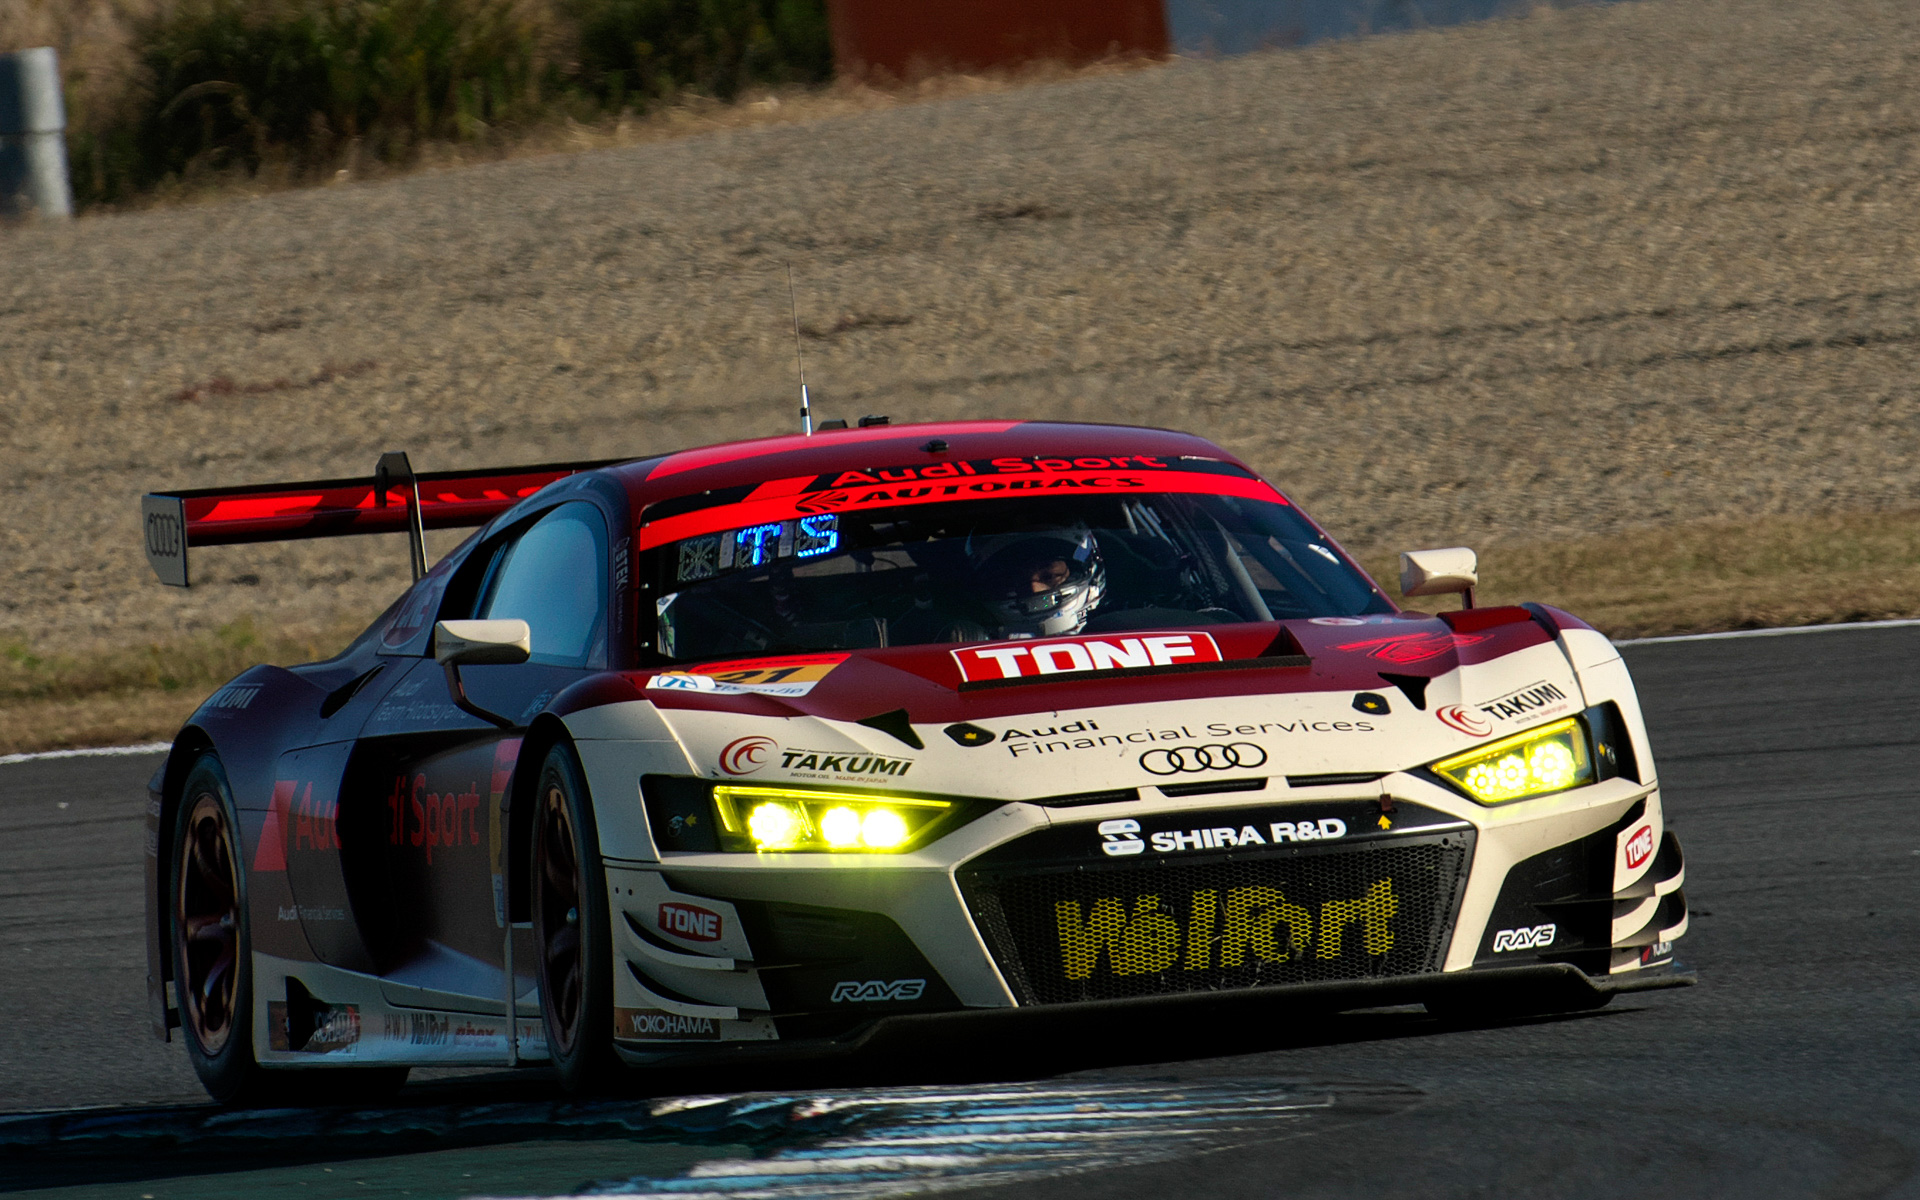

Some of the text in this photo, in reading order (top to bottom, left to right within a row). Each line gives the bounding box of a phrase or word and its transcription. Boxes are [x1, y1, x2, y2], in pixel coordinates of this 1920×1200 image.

[830, 455, 1168, 487] Audi Sport
[855, 477, 1145, 504] AUTOBACS
[1480, 683, 1568, 721] TAKUMI
[1000, 719, 1099, 742] Audi
[1007, 719, 1376, 758] Financial Services
[781, 752, 914, 776] TAKUMI
[410, 773, 480, 865] Sport
[1151, 825, 1267, 852] SHIRA
[1269, 818, 1347, 843] R&D
[1626, 829, 1653, 866] TONE
[663, 905, 719, 938] TONE
[1493, 923, 1556, 952] RAYS
[830, 979, 926, 1002] RAYS
[631, 1013, 714, 1034] YOKOHAMA
